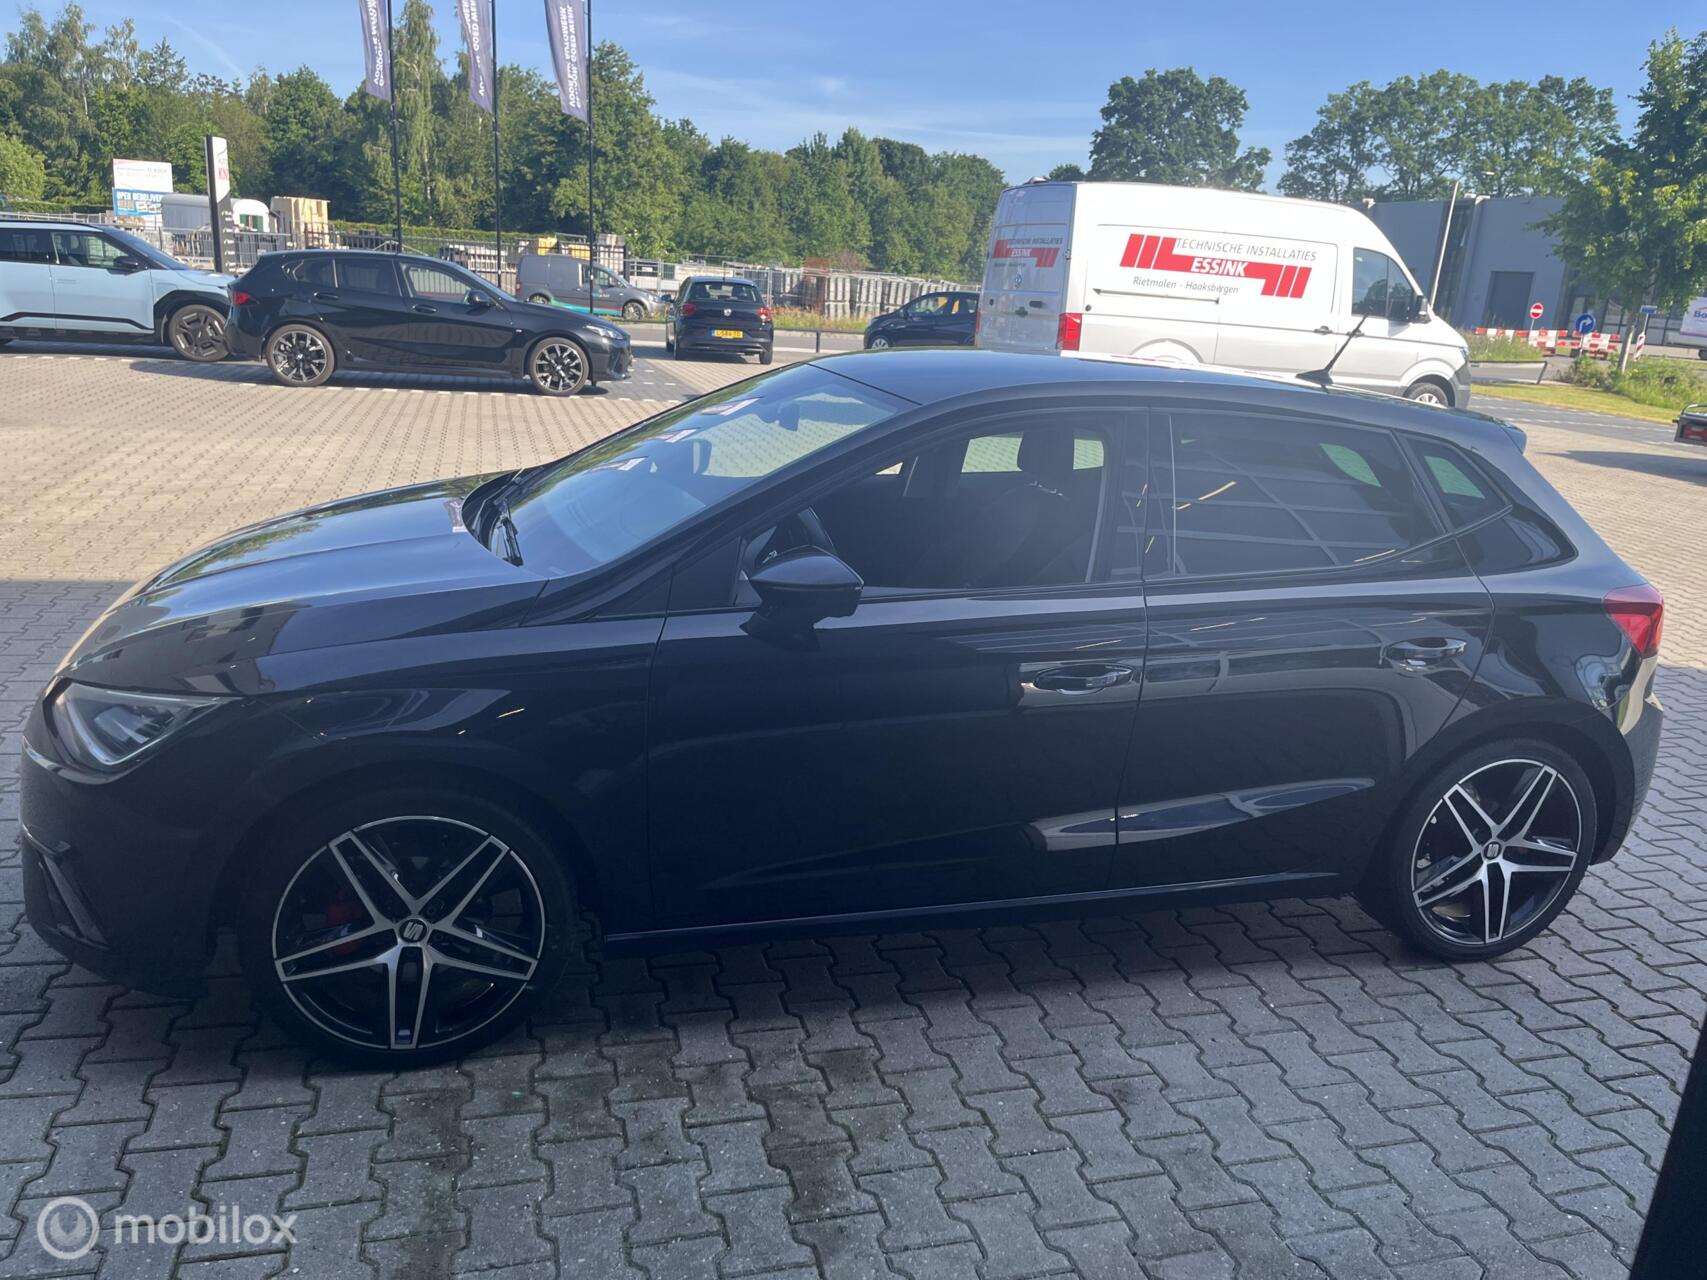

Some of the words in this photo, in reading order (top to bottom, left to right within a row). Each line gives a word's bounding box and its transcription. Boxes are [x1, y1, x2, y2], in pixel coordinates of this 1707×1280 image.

[1176, 238, 1243, 255] TECHNISCHE
[1245, 245, 1318, 262] INSTALLATIES
[1190, 257, 1249, 277] ESSINK
[1132, 275, 1177, 290] Rietmolen
[1184, 280, 1239, 295] Haaksbergen
